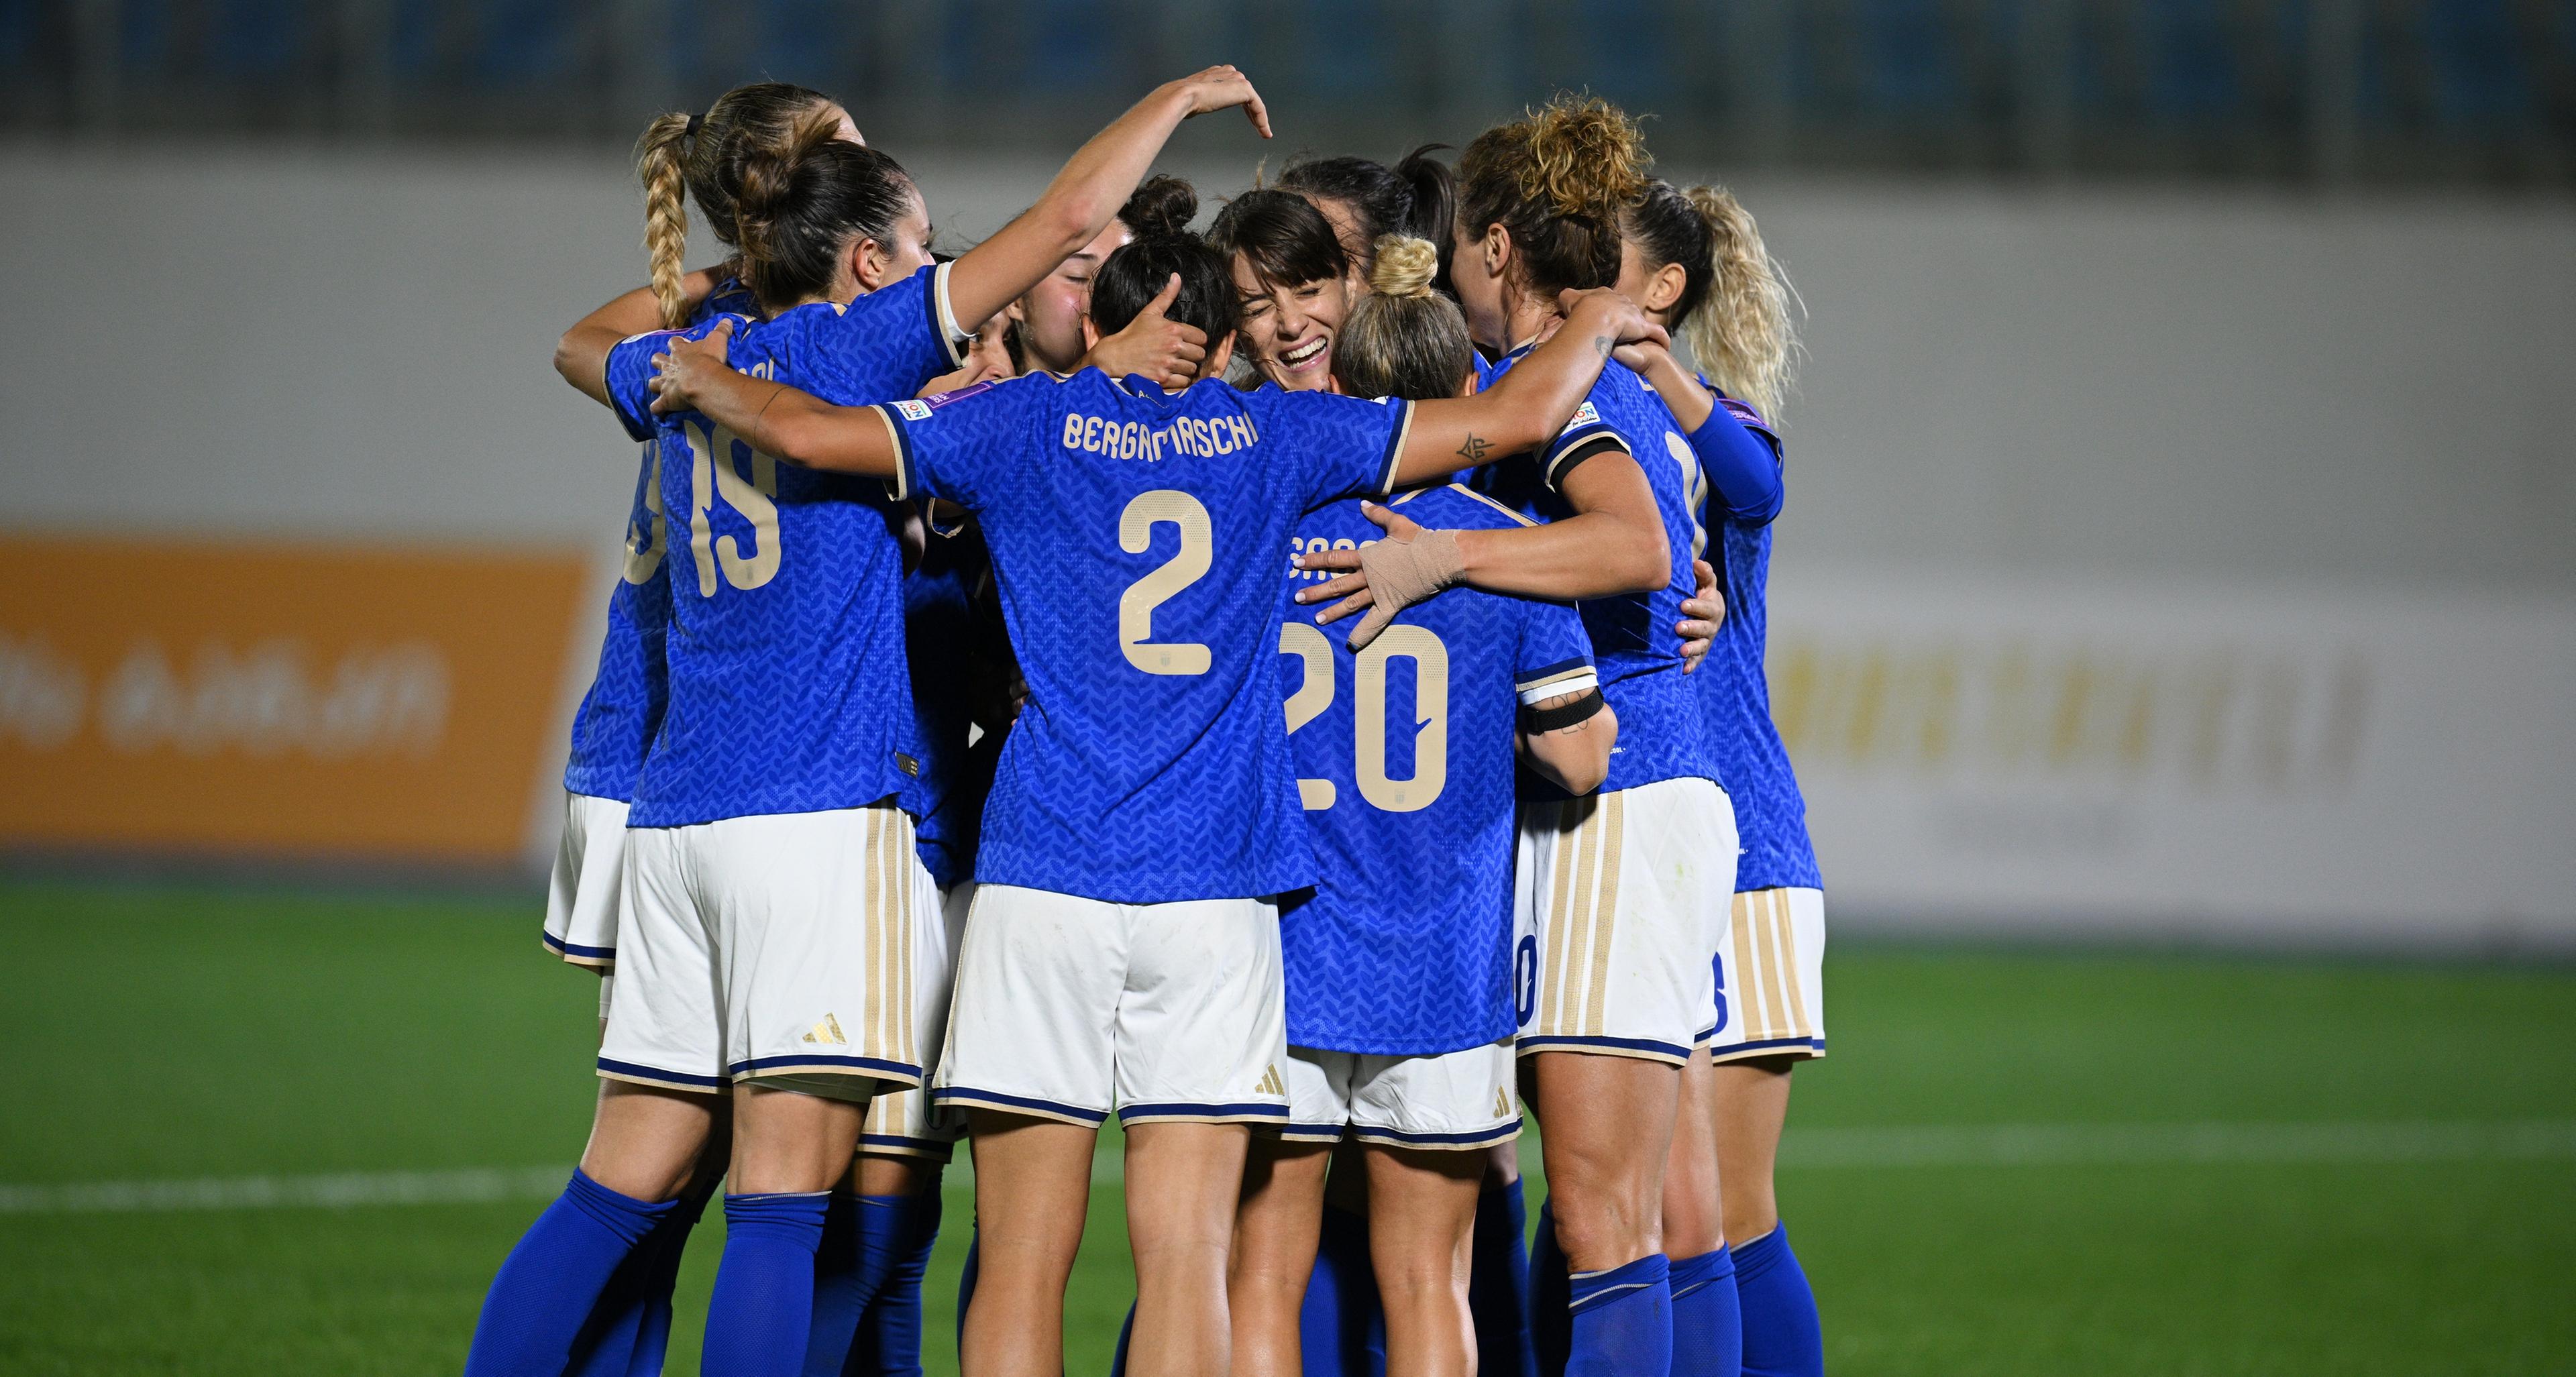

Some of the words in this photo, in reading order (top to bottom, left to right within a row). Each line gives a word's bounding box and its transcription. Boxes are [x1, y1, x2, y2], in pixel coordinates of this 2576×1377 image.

[684, 420, 782, 598] 19
[1063, 411, 1259, 463] BERGAMASCHI
[1118, 489, 1213, 675] 2
[1278, 622, 1449, 812] 20
